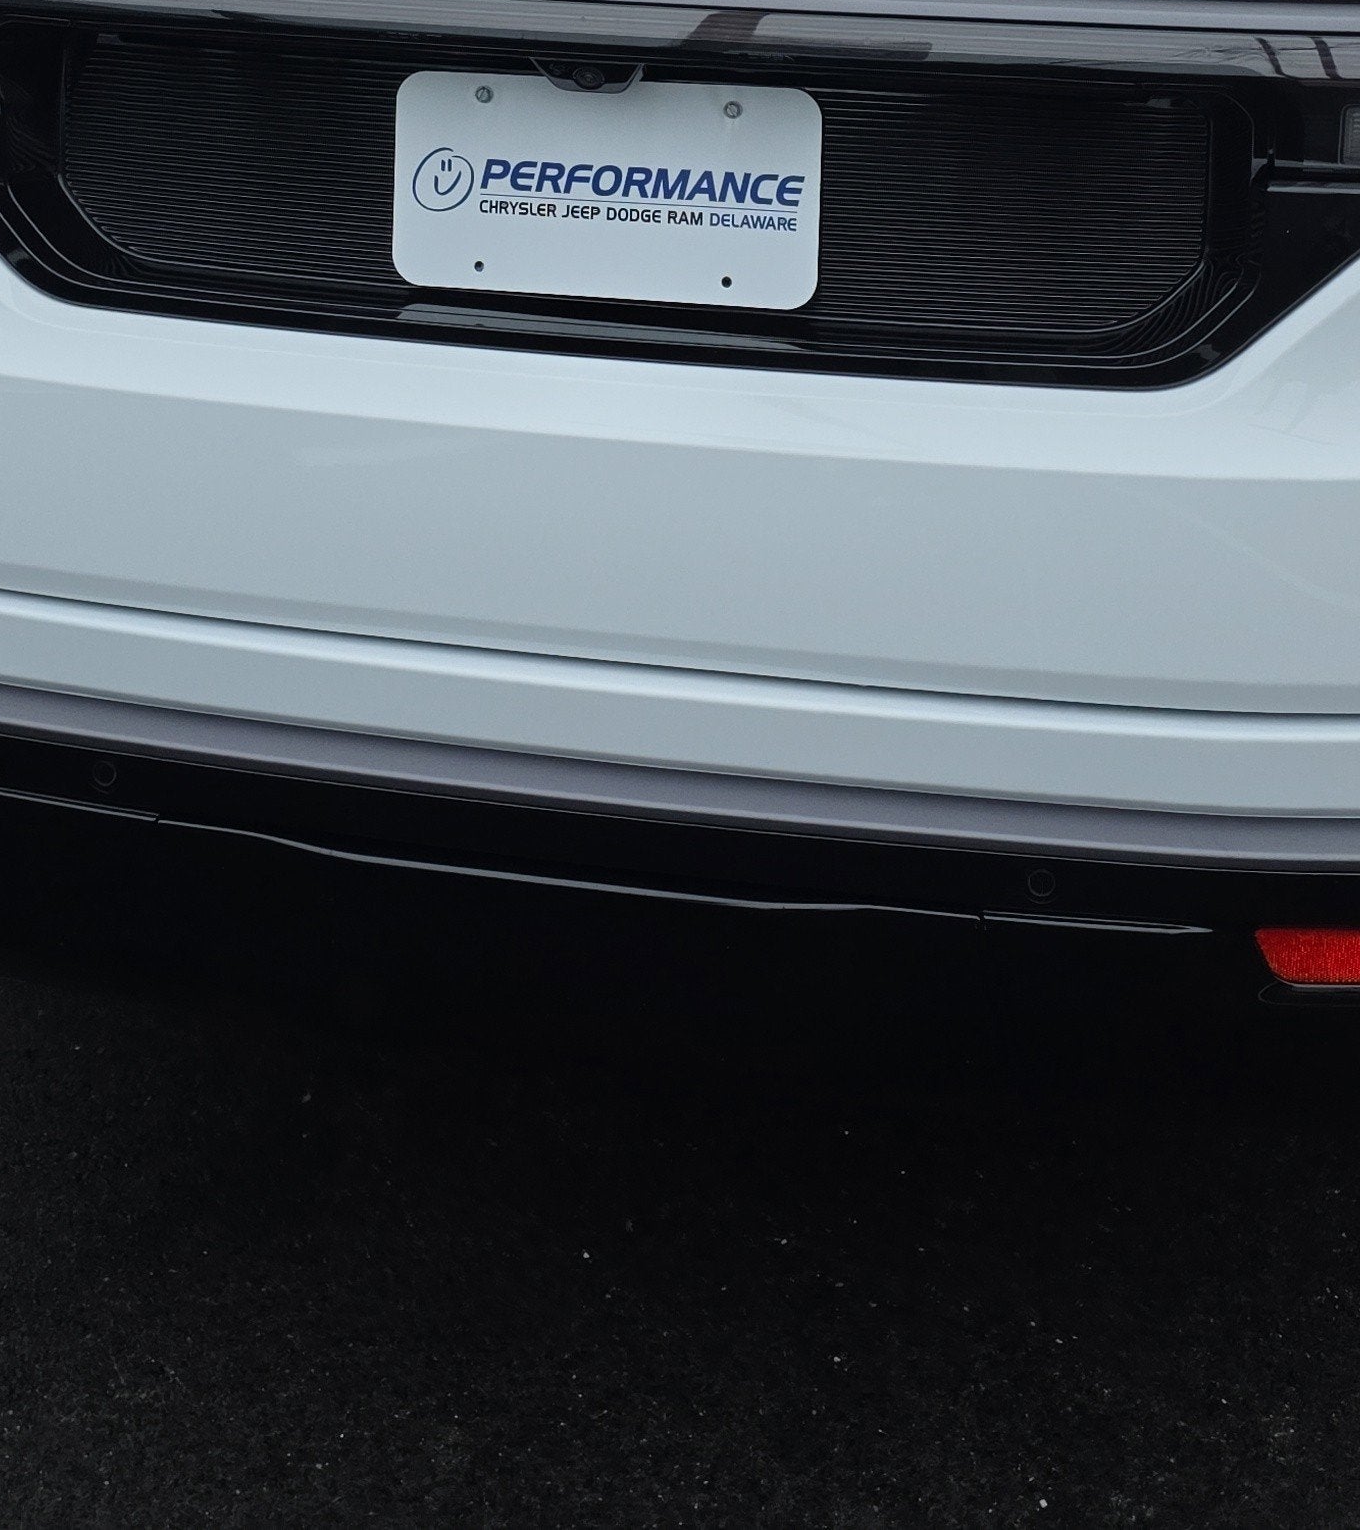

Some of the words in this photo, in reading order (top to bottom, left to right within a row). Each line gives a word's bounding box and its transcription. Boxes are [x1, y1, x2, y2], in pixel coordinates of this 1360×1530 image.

[480, 158, 805, 207] PERFORMANCE
[479, 199, 557, 218] CHRYSLER
[562, 204, 601, 220] JEEP
[606, 206, 662, 223] DODGE
[667, 210, 703, 226] RAM
[709, 212, 797, 232] DELAWARE
